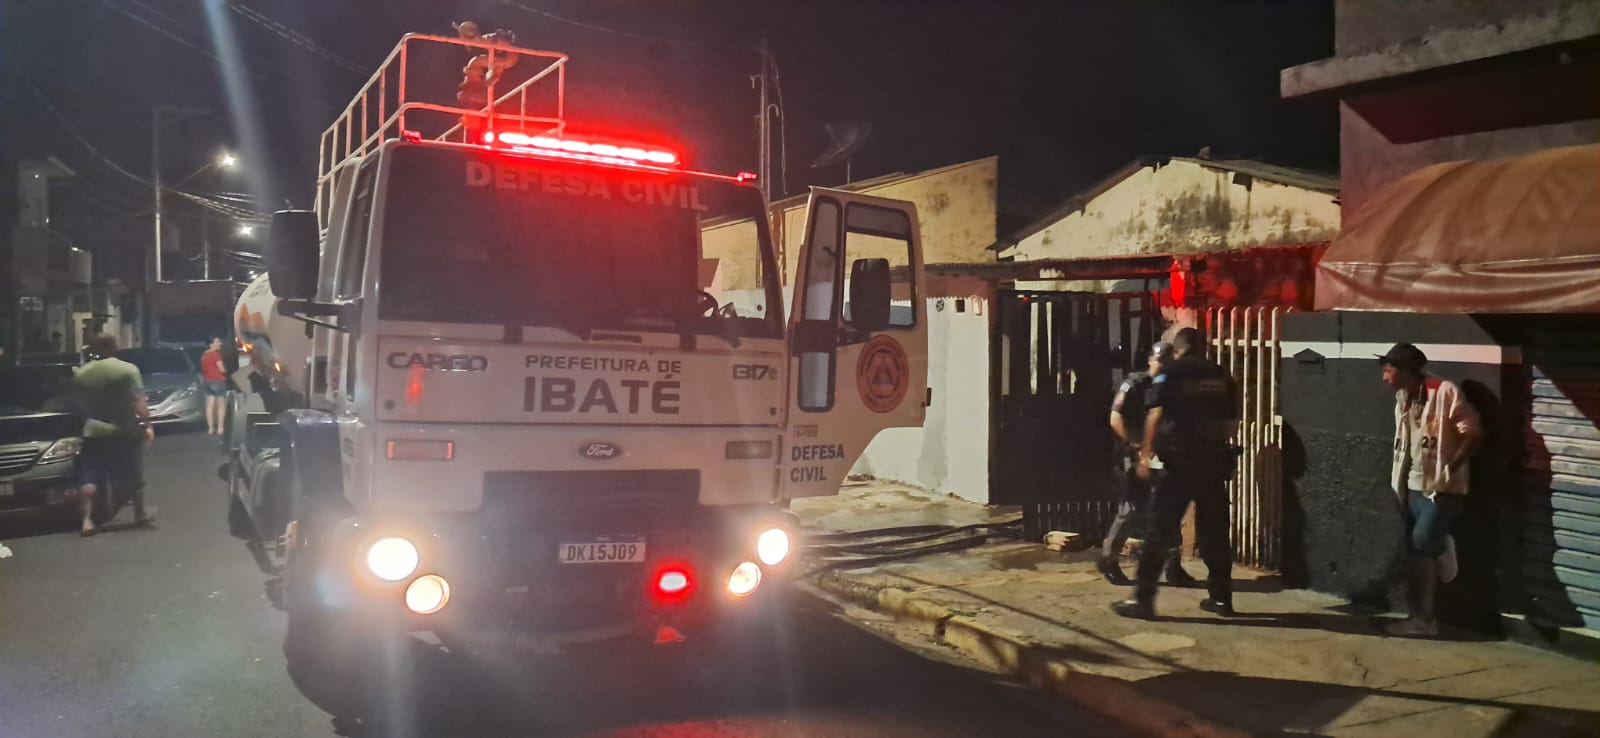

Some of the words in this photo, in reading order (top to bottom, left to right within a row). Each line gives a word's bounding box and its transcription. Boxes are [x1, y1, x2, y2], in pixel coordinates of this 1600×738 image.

[465, 161, 610, 199] DEFESA
[621, 178, 707, 211] CIVIL
[387, 352, 488, 372] CARGO
[525, 355, 650, 372] PREFEITURA
[657, 360, 681, 373] DE
[523, 374, 681, 414] IBATÉ
[586, 443, 615, 456] Ford
[791, 443, 844, 461] DEFESA
[790, 466, 827, 482] CIVIL
